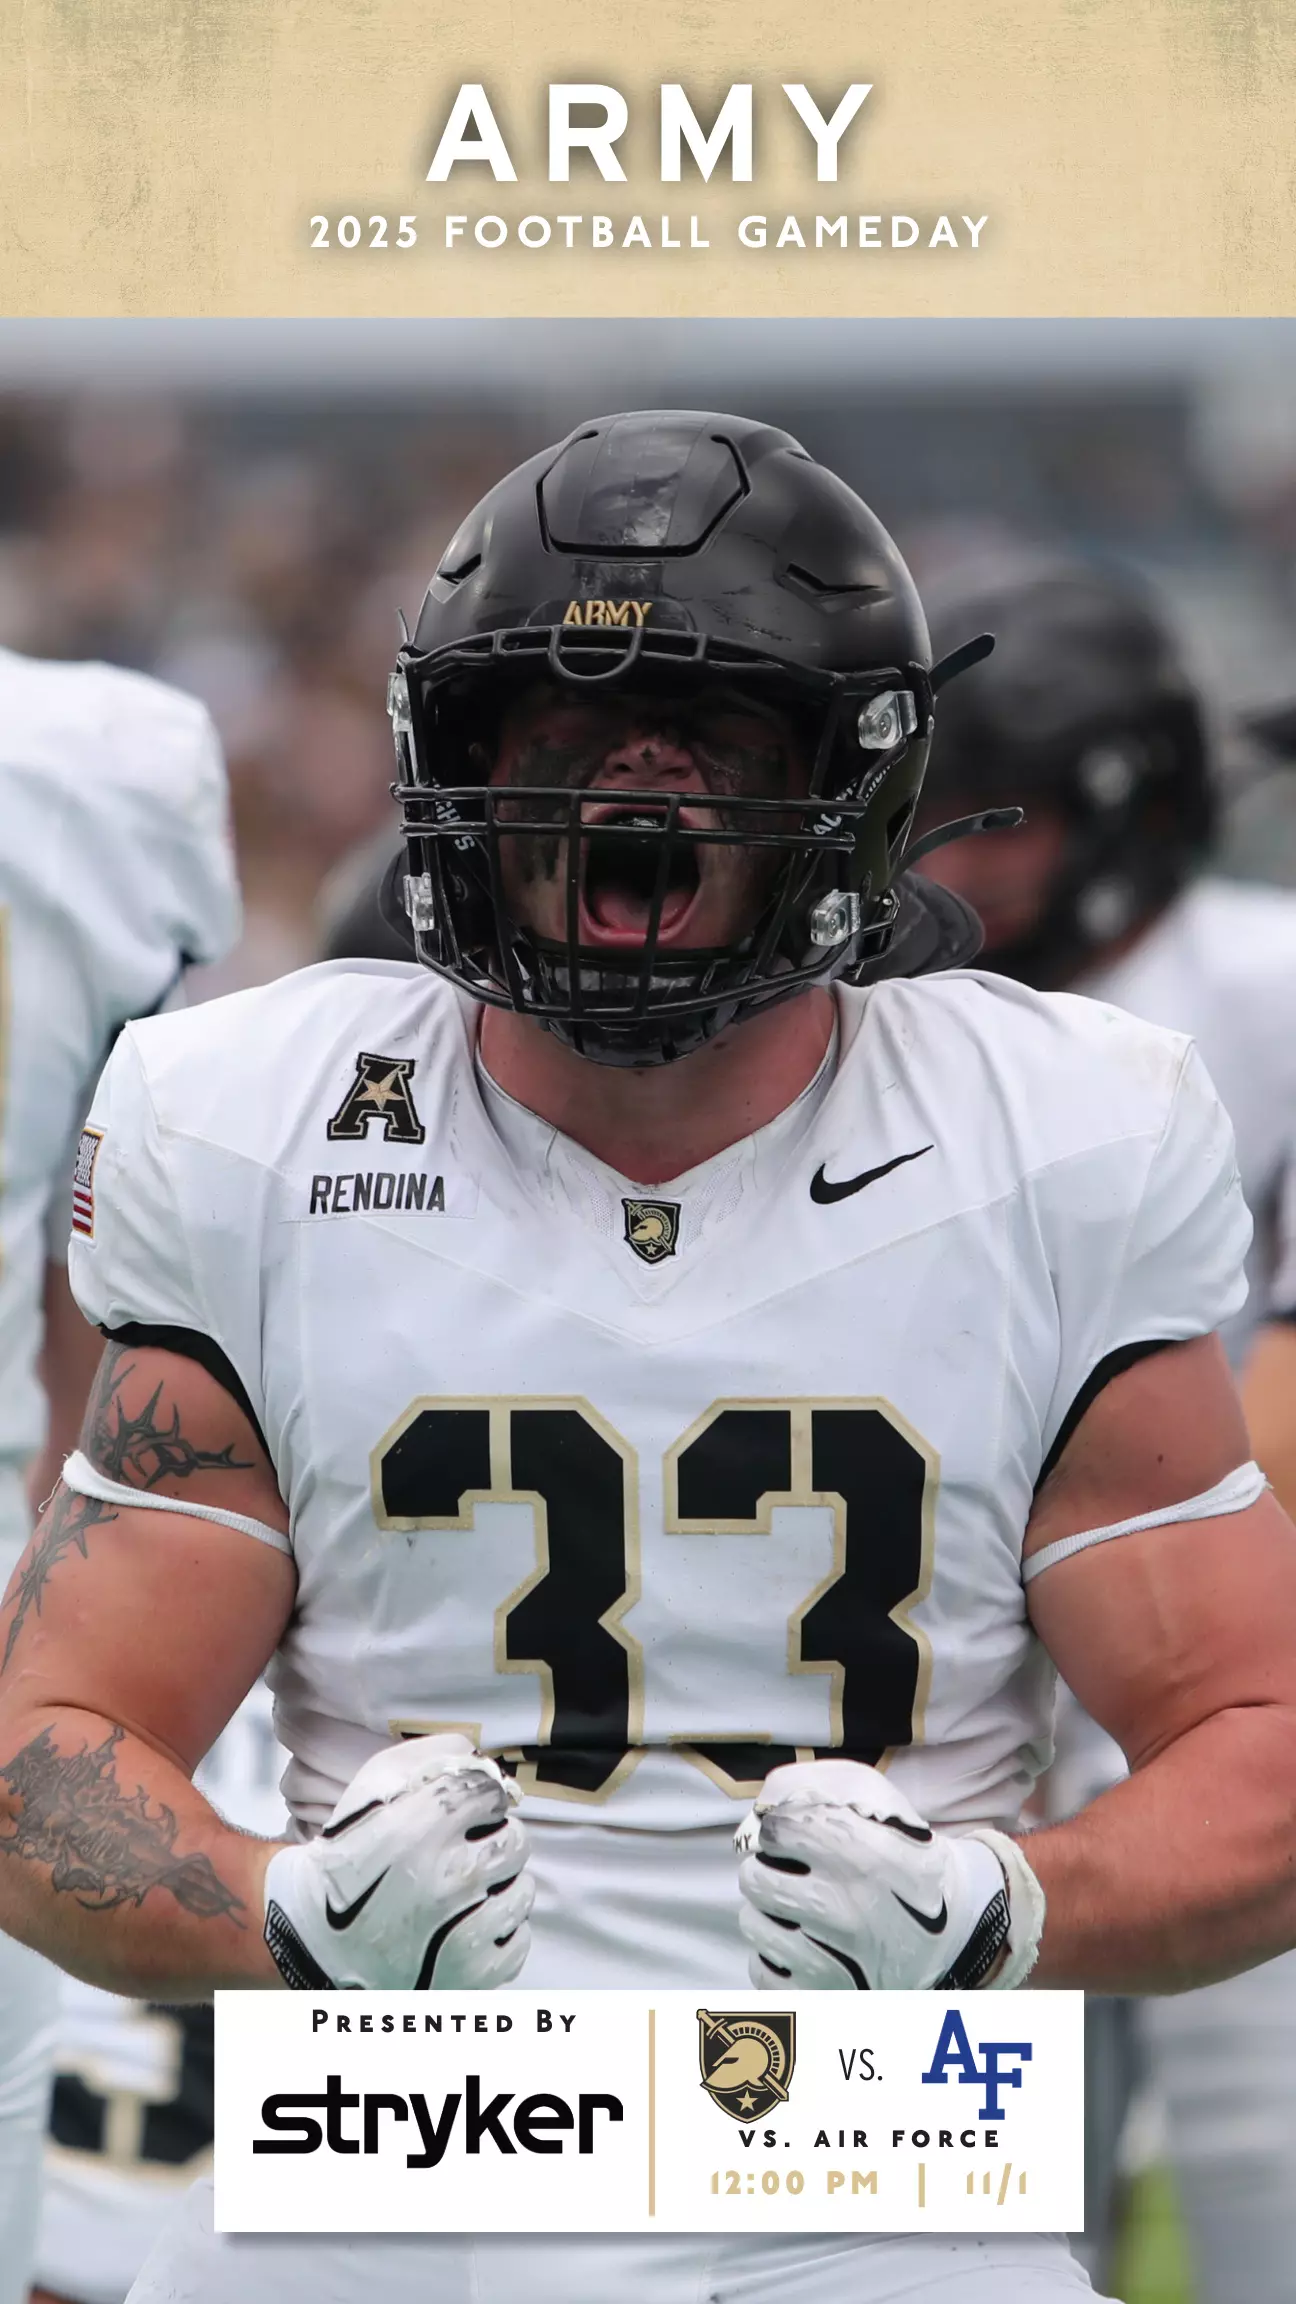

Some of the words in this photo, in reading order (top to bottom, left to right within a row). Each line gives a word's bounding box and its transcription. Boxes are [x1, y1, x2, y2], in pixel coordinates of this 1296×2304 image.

[562, 600, 653, 627] ARMY
[309, 1173, 445, 1214] RENDINA
[370, 1395, 940, 1800] 33
